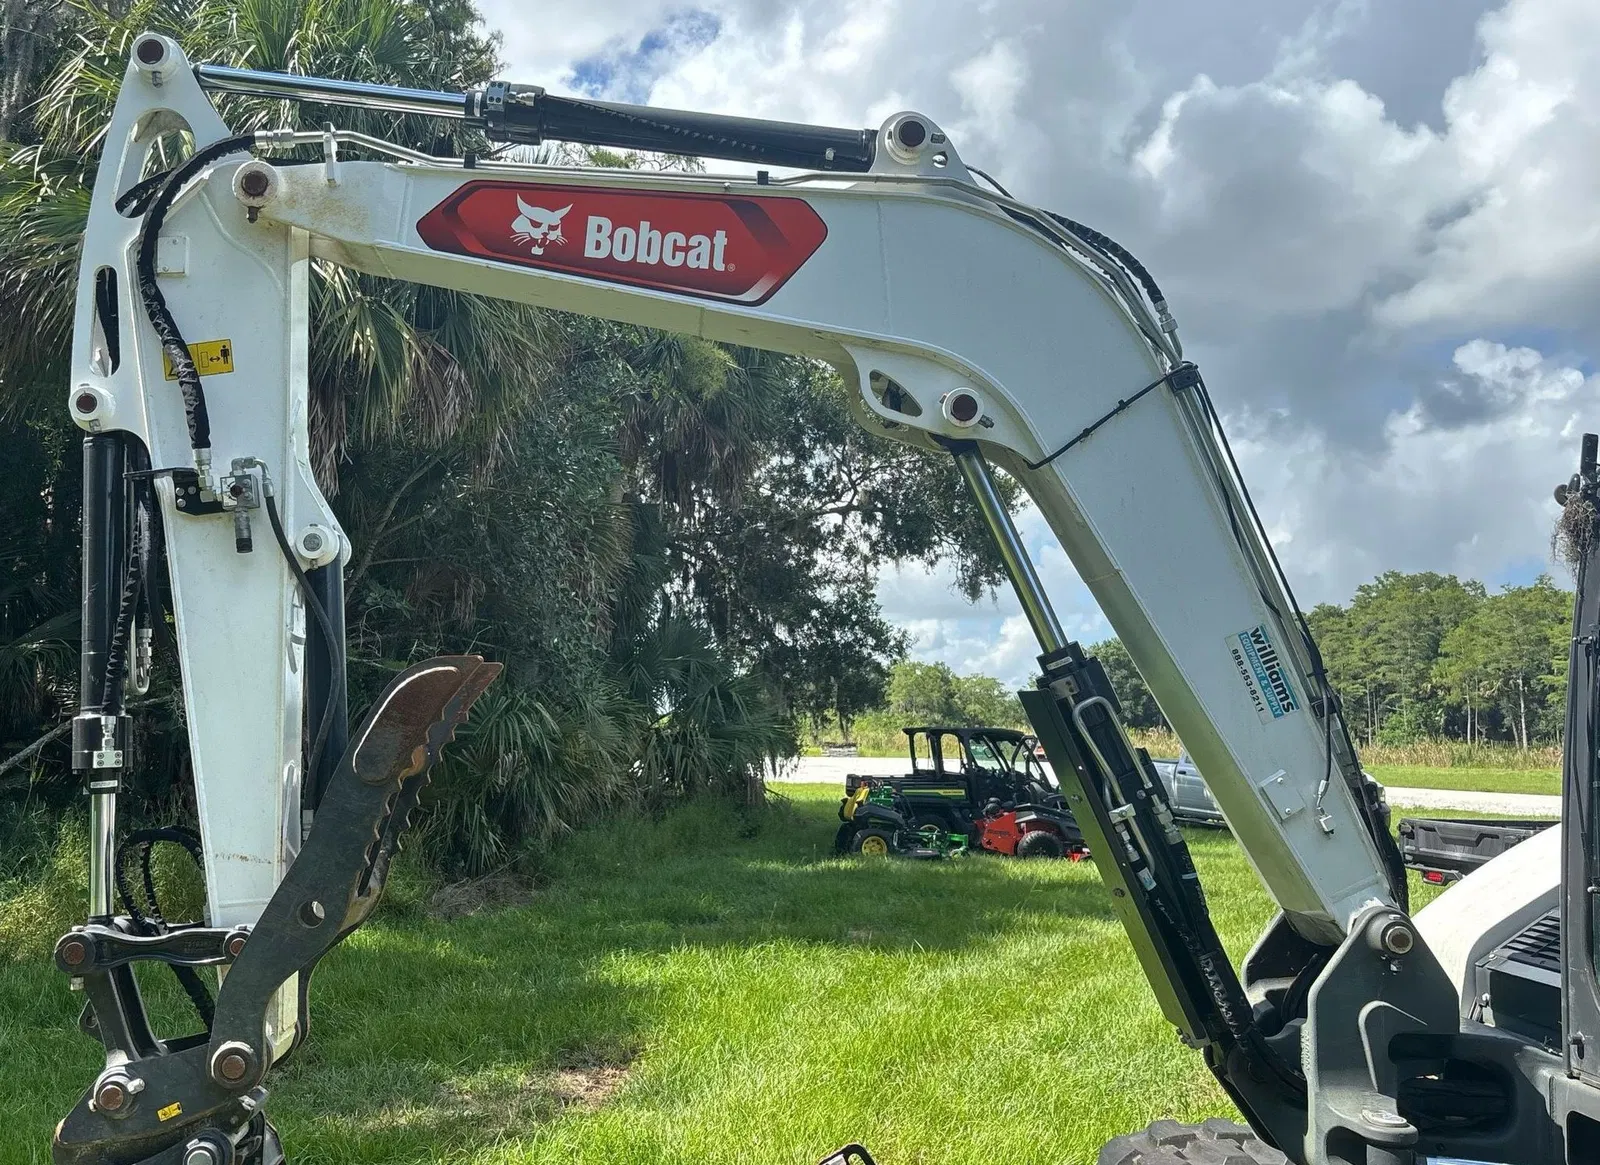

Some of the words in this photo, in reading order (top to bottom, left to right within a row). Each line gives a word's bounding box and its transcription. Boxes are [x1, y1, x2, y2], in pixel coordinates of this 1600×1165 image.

[584, 215, 728, 272] Bobcat
[1231, 648, 1265, 713] 888-553-8211
[1240, 633, 1266, 681] EQUIPMENT
[1264, 687, 1283, 715] SUPPLY
[1249, 627, 1295, 713] williams
